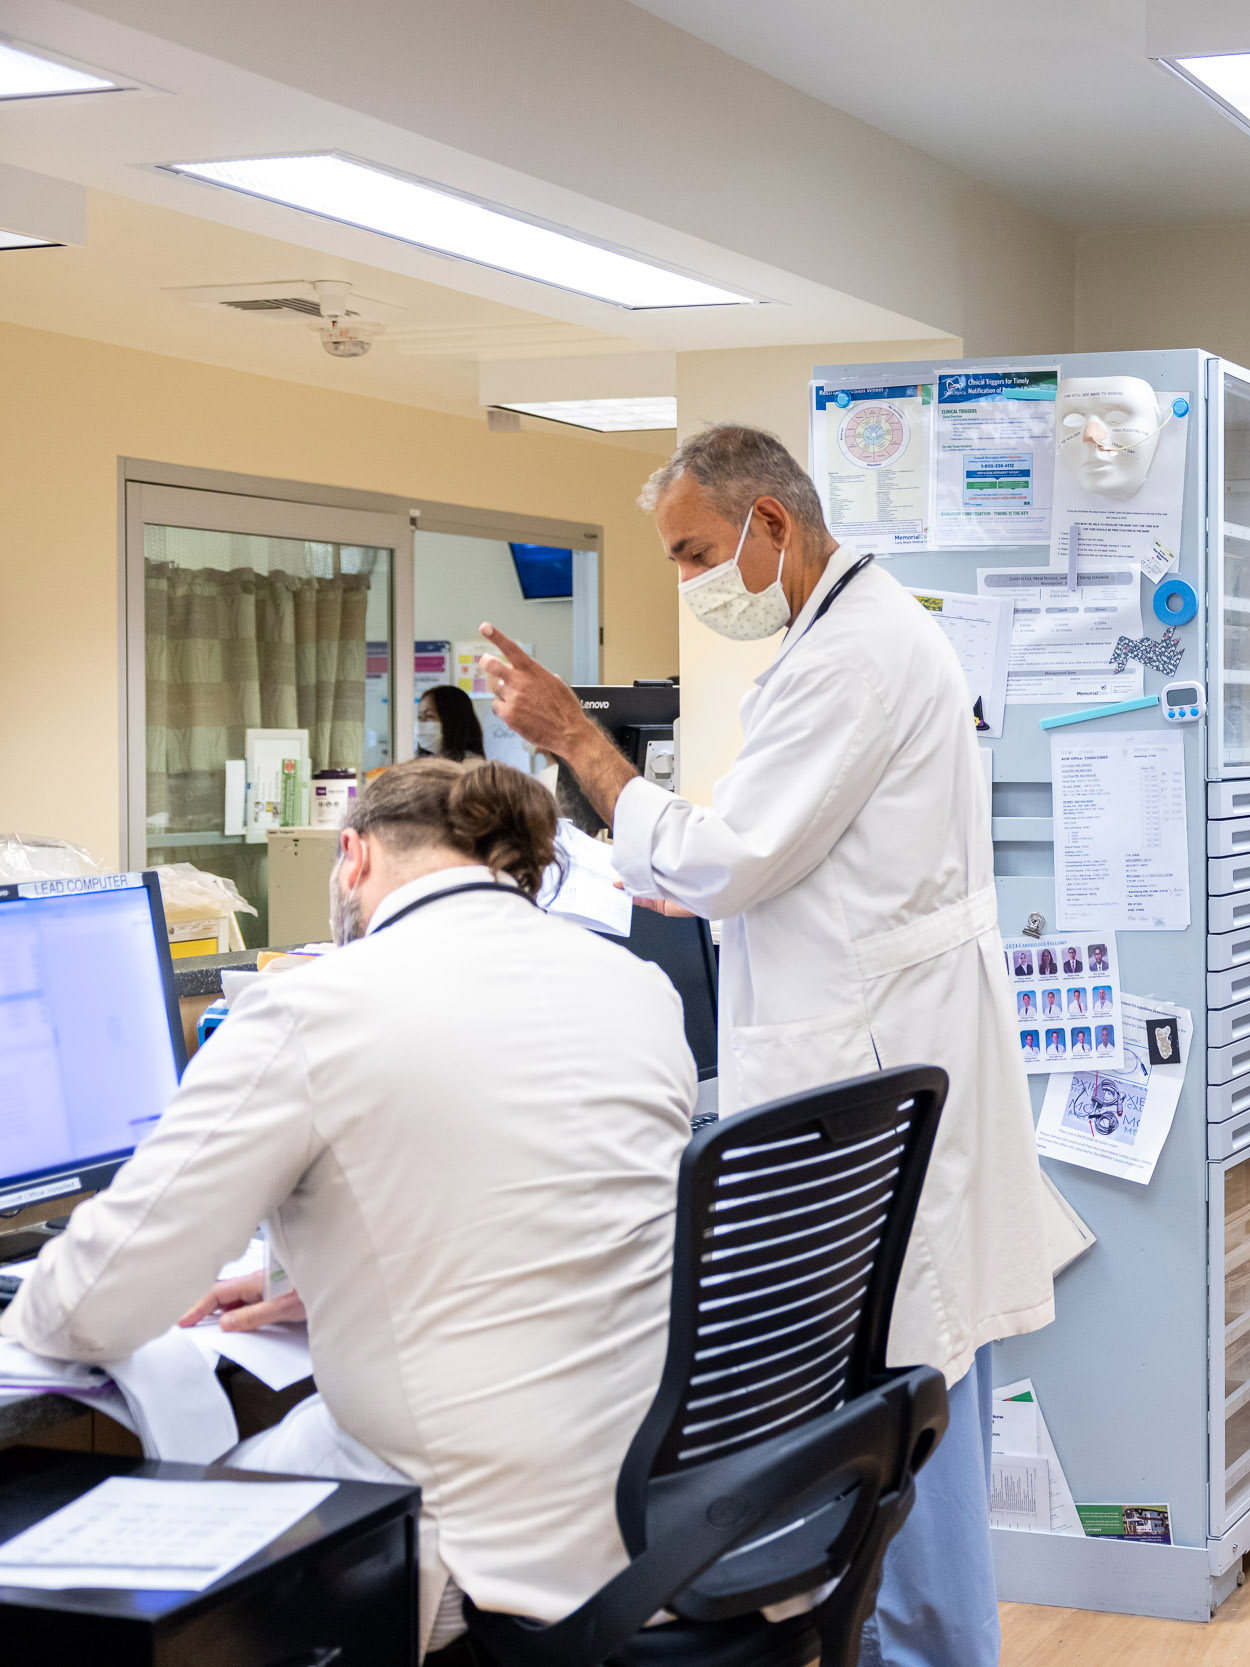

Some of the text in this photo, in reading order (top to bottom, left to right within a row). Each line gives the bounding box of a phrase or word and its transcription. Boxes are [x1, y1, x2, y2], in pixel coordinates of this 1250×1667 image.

[580, 700, 609, 709] Lenovo
[34, 875, 128, 896] LEAD COMPUTER
